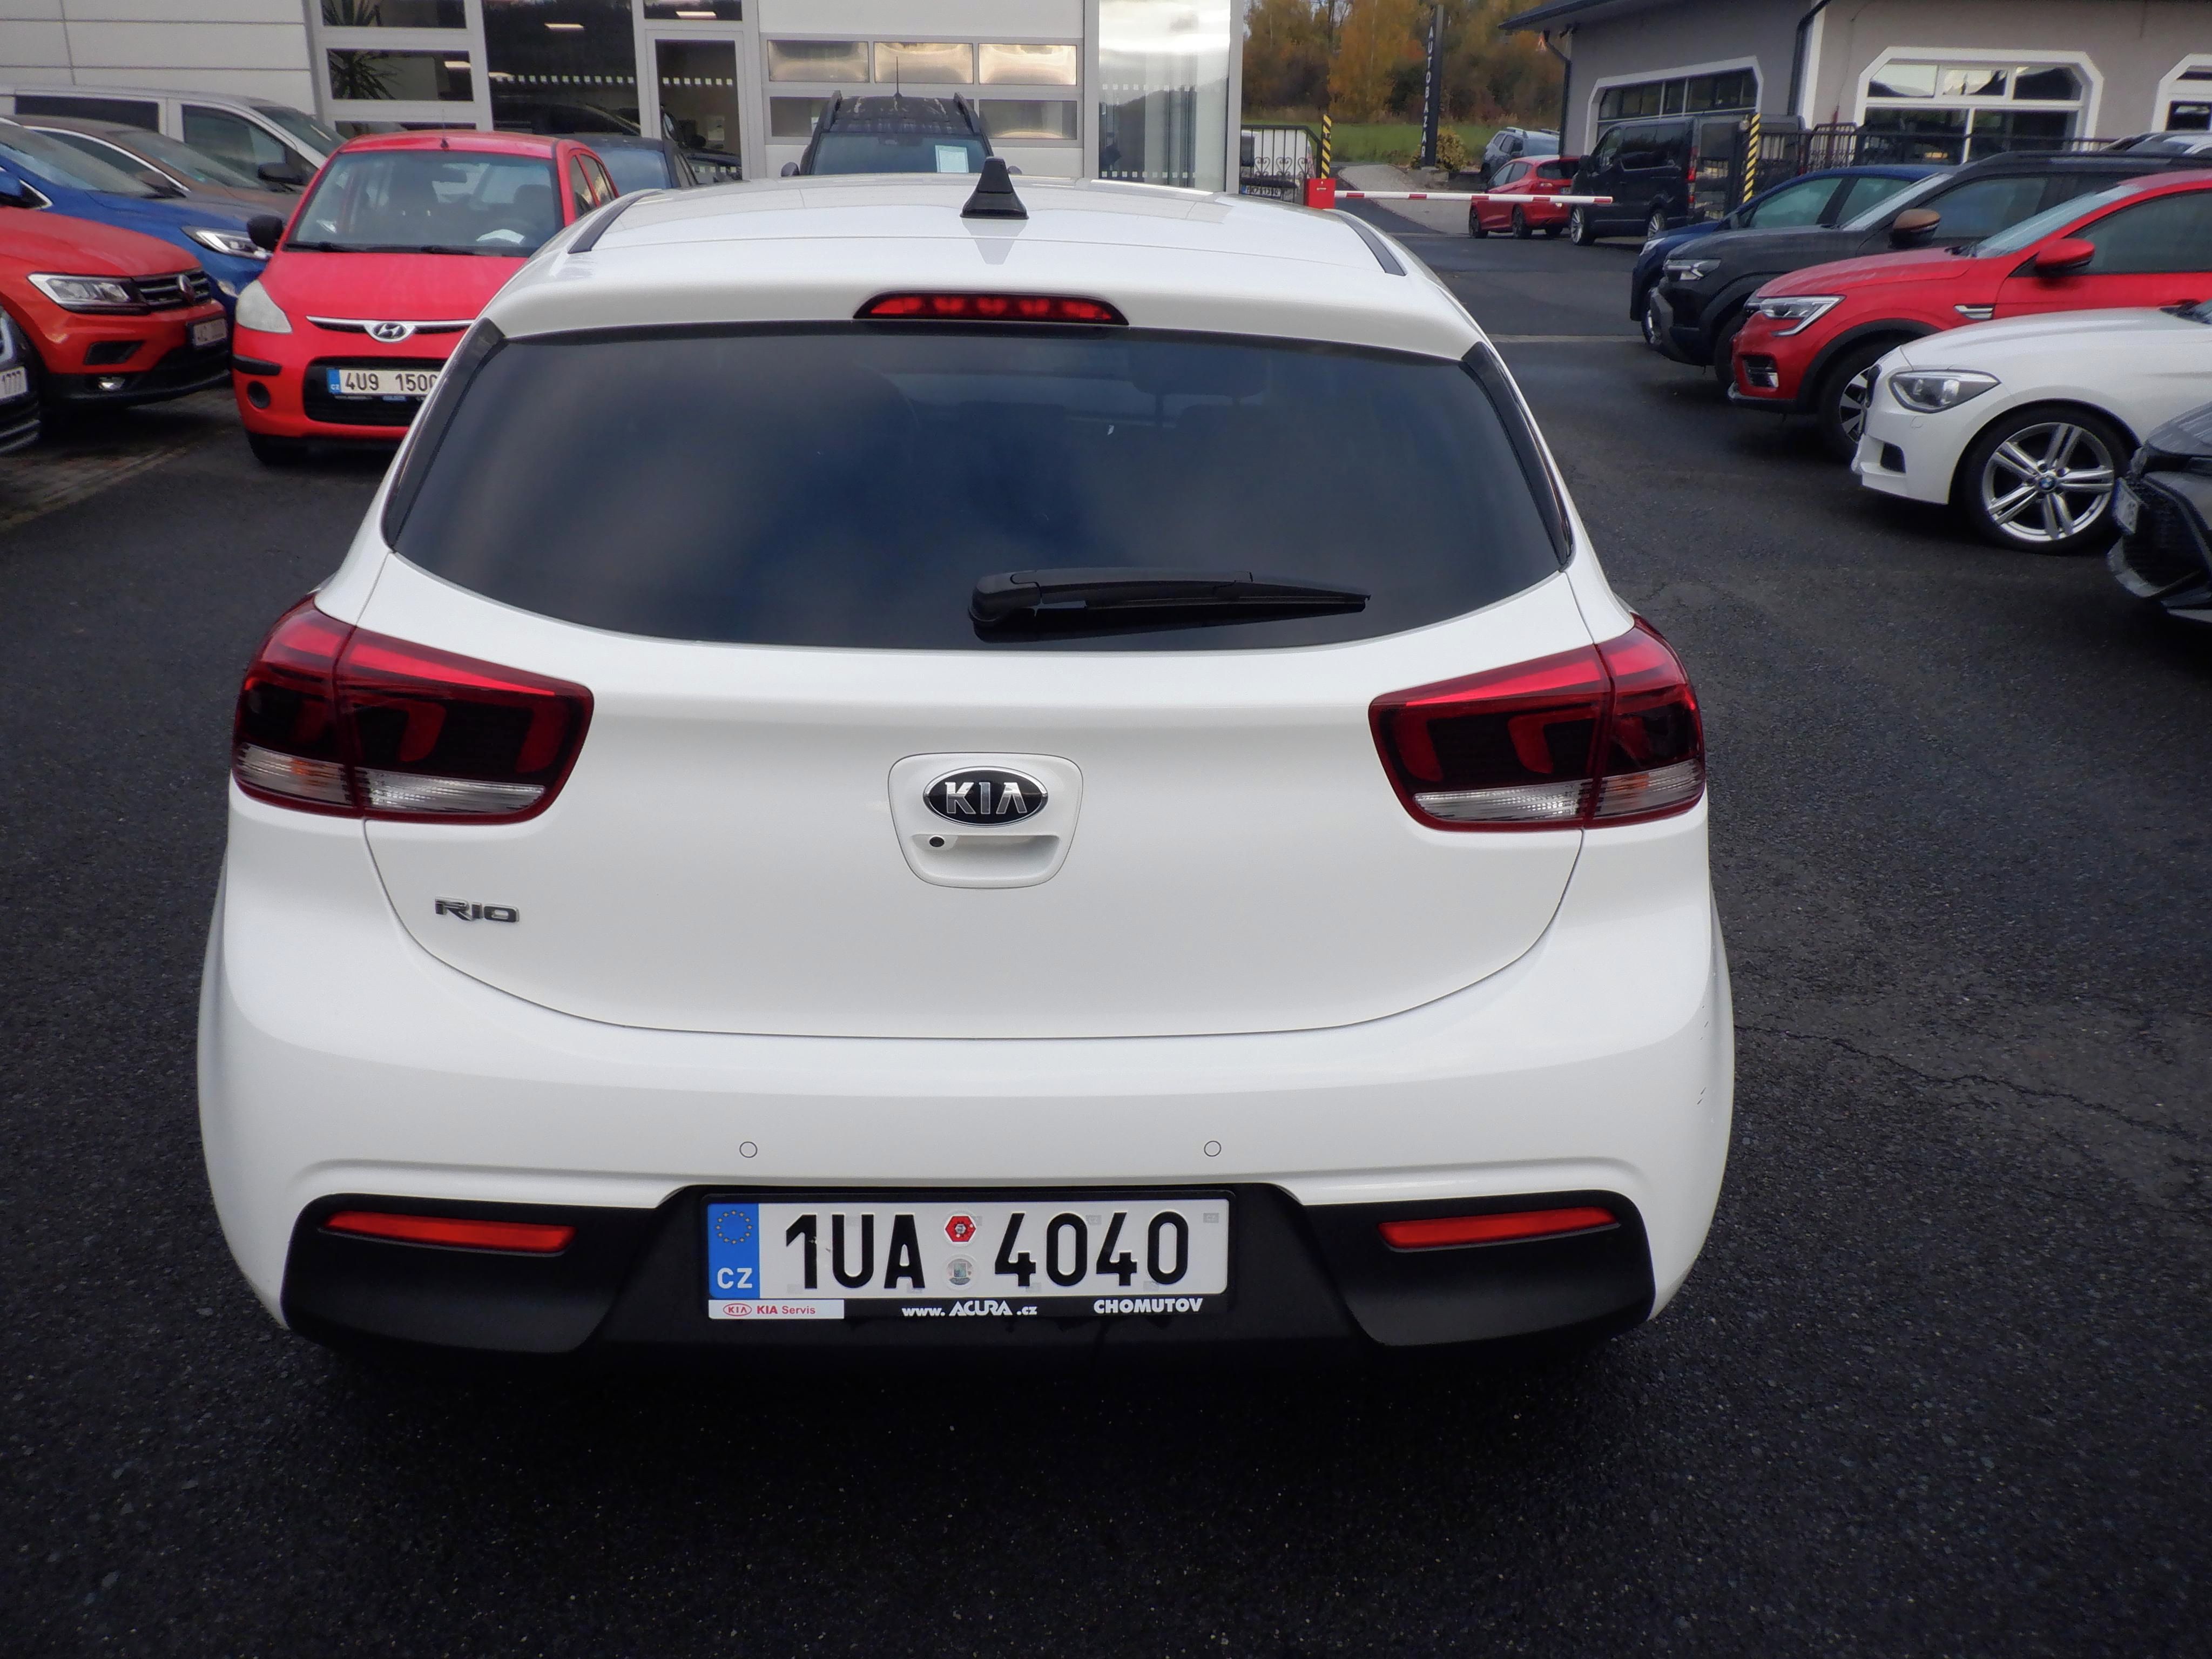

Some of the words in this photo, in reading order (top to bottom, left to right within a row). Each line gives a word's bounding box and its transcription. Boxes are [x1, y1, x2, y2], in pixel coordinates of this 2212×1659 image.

[1421, 26, 1434, 158] AUTOBAZAR
[345, 372, 379, 390] 4U9
[945, 781, 1028, 814] KIA
[435, 896, 520, 923] RIO
[786, 1213, 926, 1289] 1UA
[994, 1211, 1189, 1287] 4040
[717, 1267, 752, 1289] CZ
[757, 1305, 778, 1314] KIA
[781, 1305, 816, 1314] Servis
[1094, 1298, 1203, 1314] CHOMUTOV
